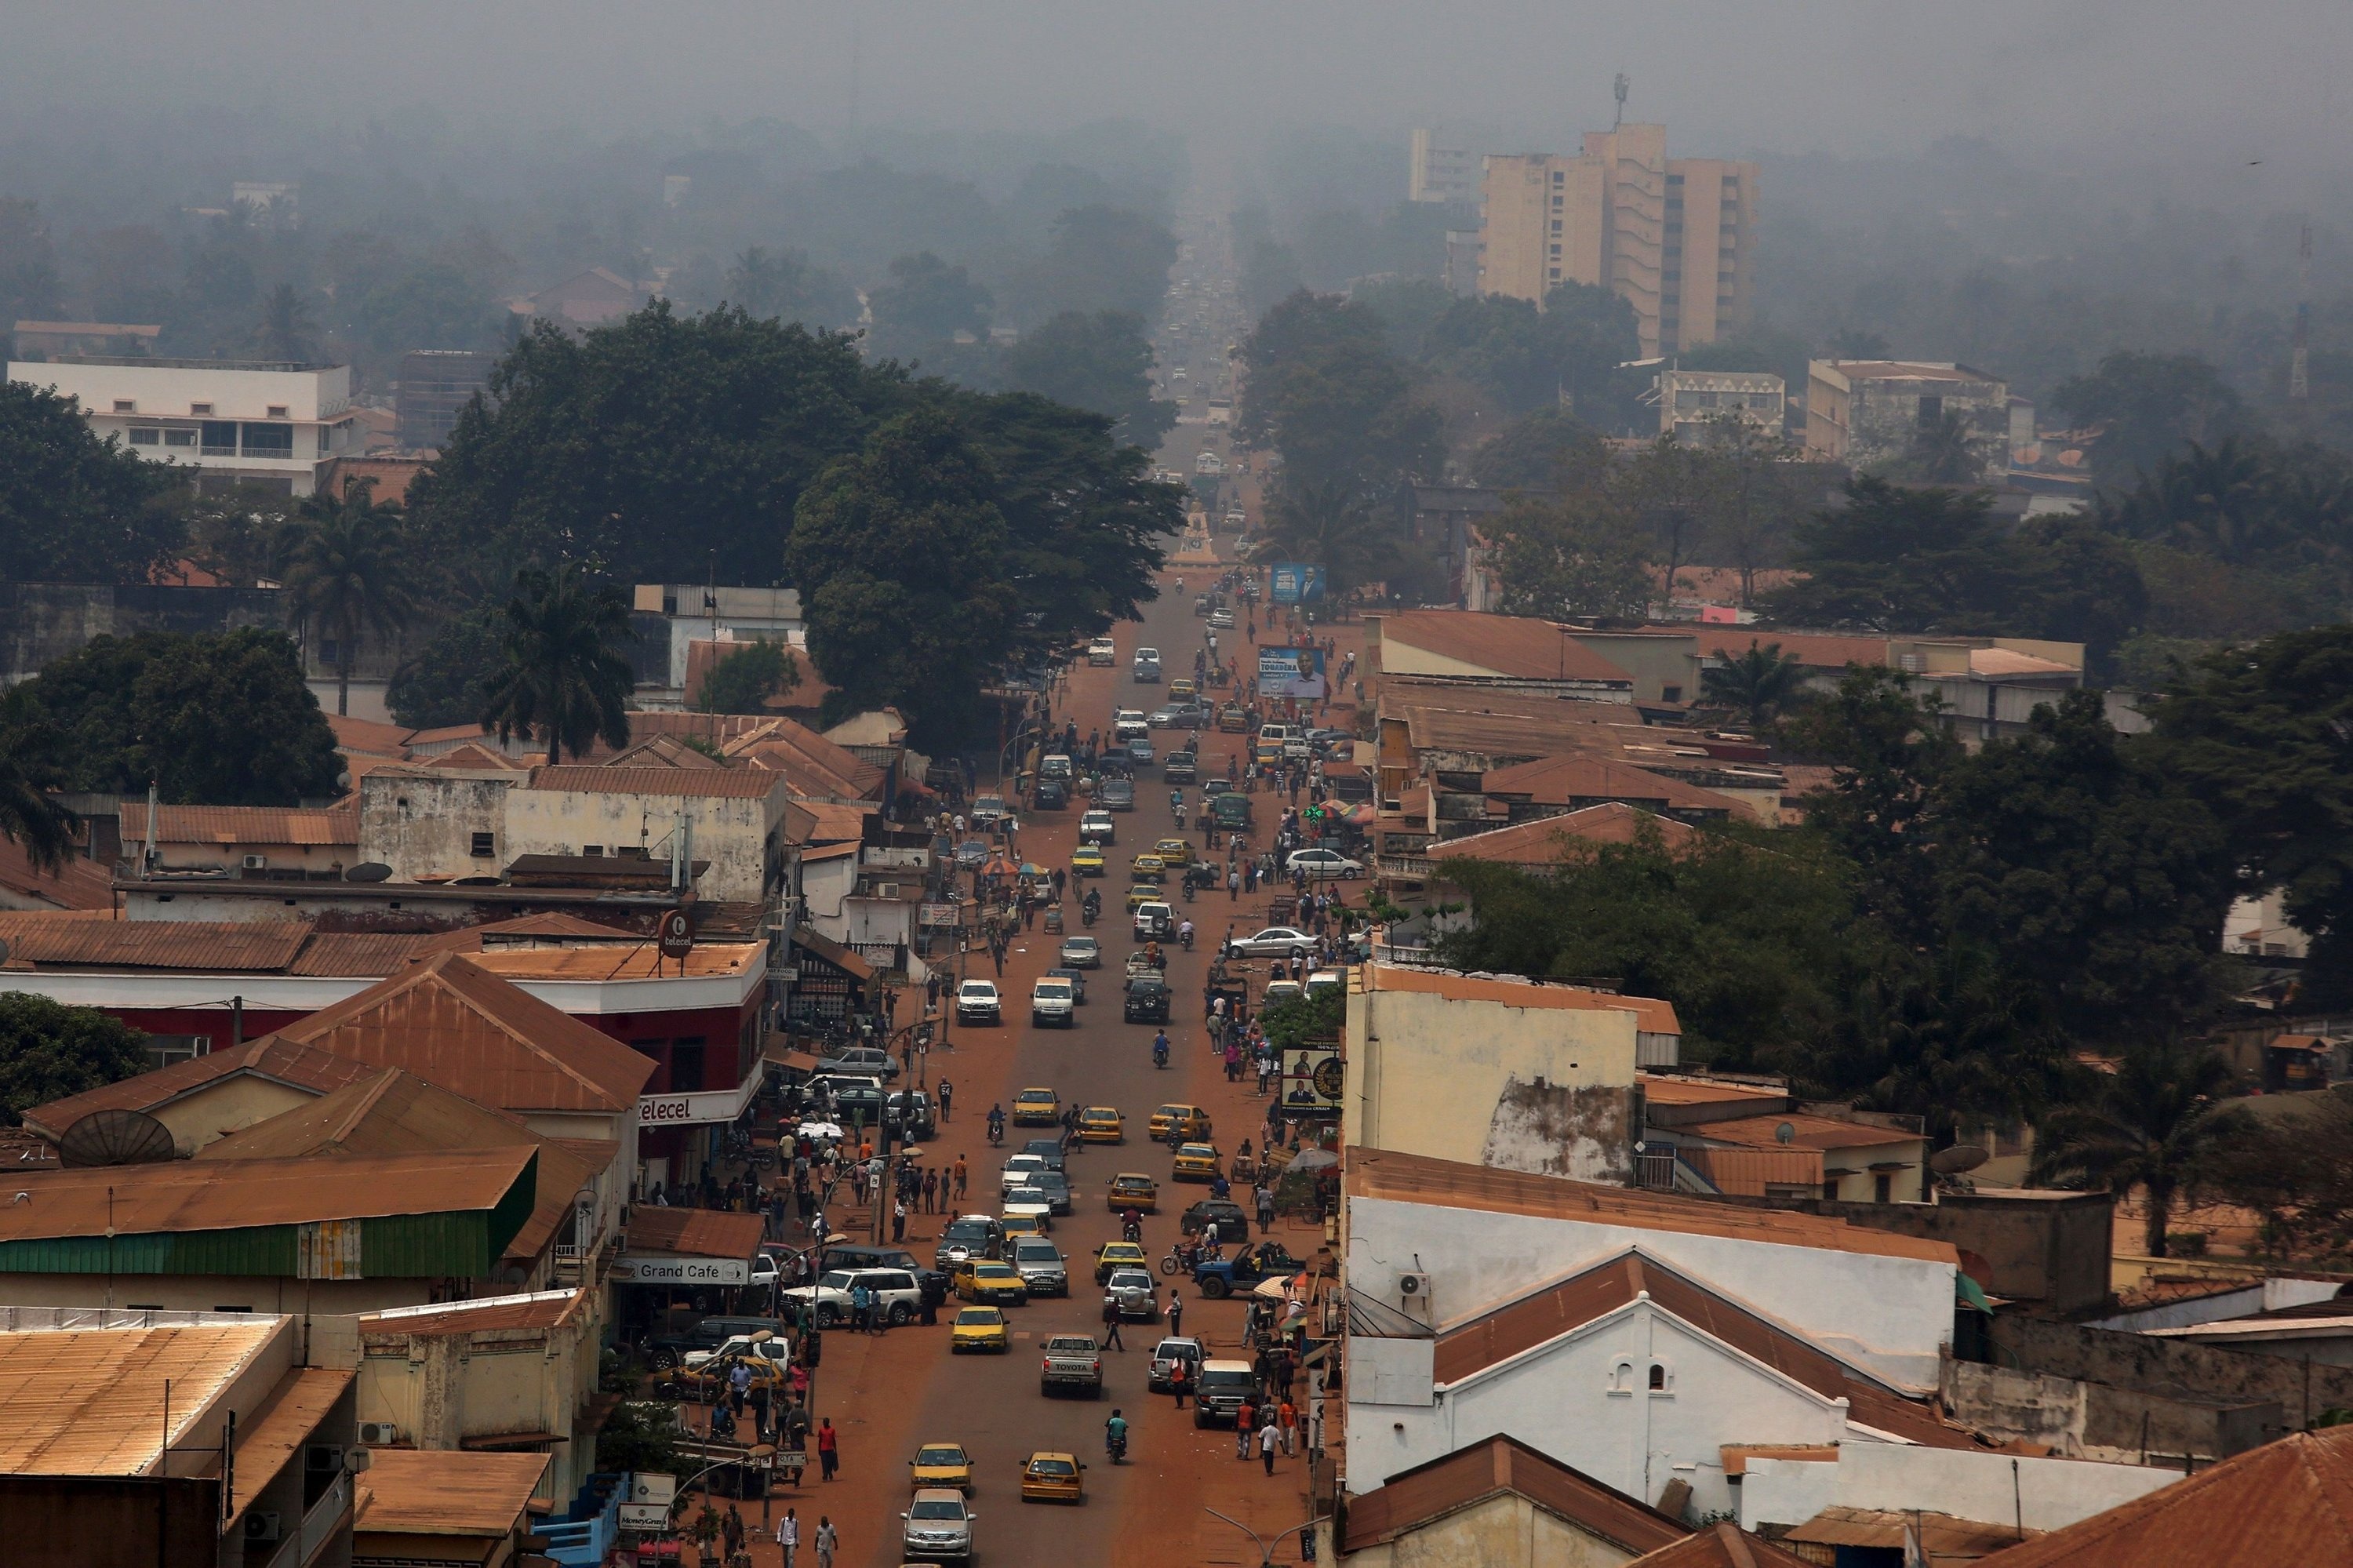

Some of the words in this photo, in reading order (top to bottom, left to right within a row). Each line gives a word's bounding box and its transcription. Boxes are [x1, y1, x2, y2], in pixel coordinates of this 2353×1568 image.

[665, 936, 692, 946] telecel
[642, 1264, 682, 1278] Grand
[688, 1265, 719, 1279] Café
[621, 1517, 667, 1526] MoneyGram
